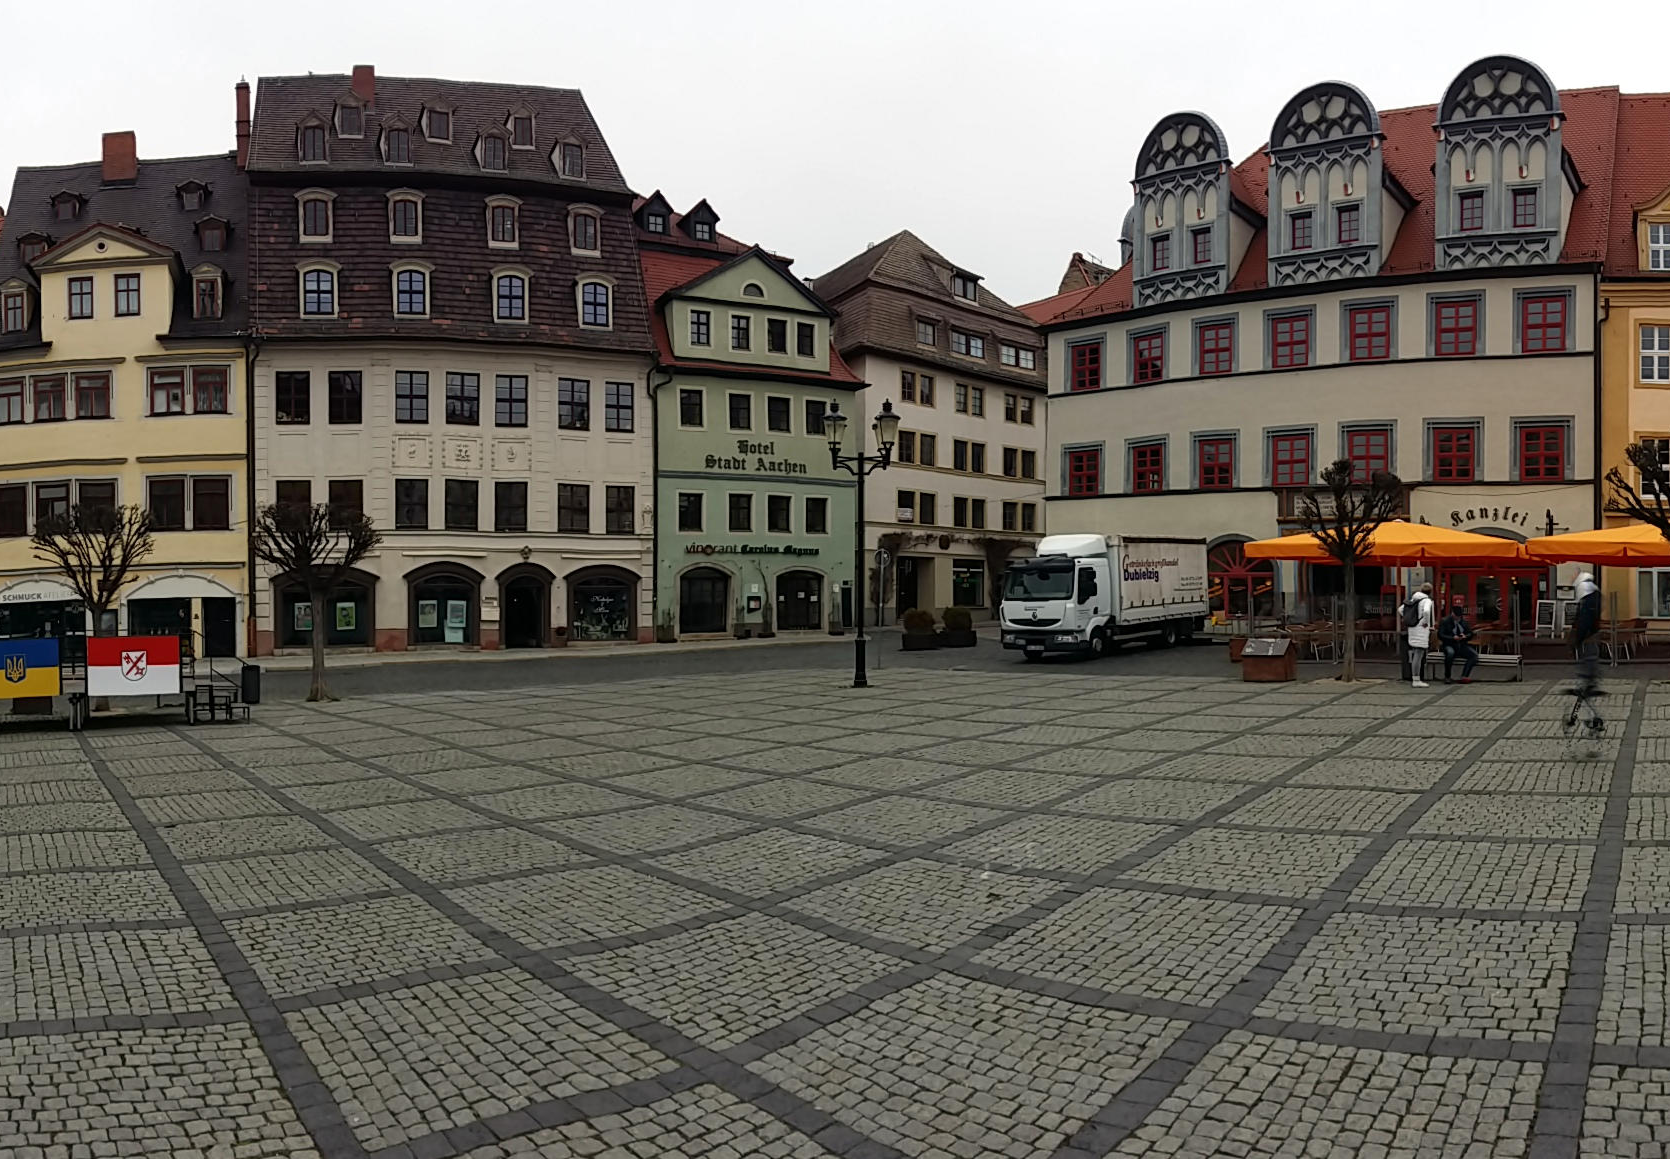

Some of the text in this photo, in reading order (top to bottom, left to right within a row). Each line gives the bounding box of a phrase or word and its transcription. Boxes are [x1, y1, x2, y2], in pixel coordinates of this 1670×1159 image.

[737, 440, 775, 456] Hotel
[705, 454, 808, 475] Stadt Aachen
[1450, 505, 1529, 527] Kanzlei
[1123, 567, 1160, 582] Dubielzig
